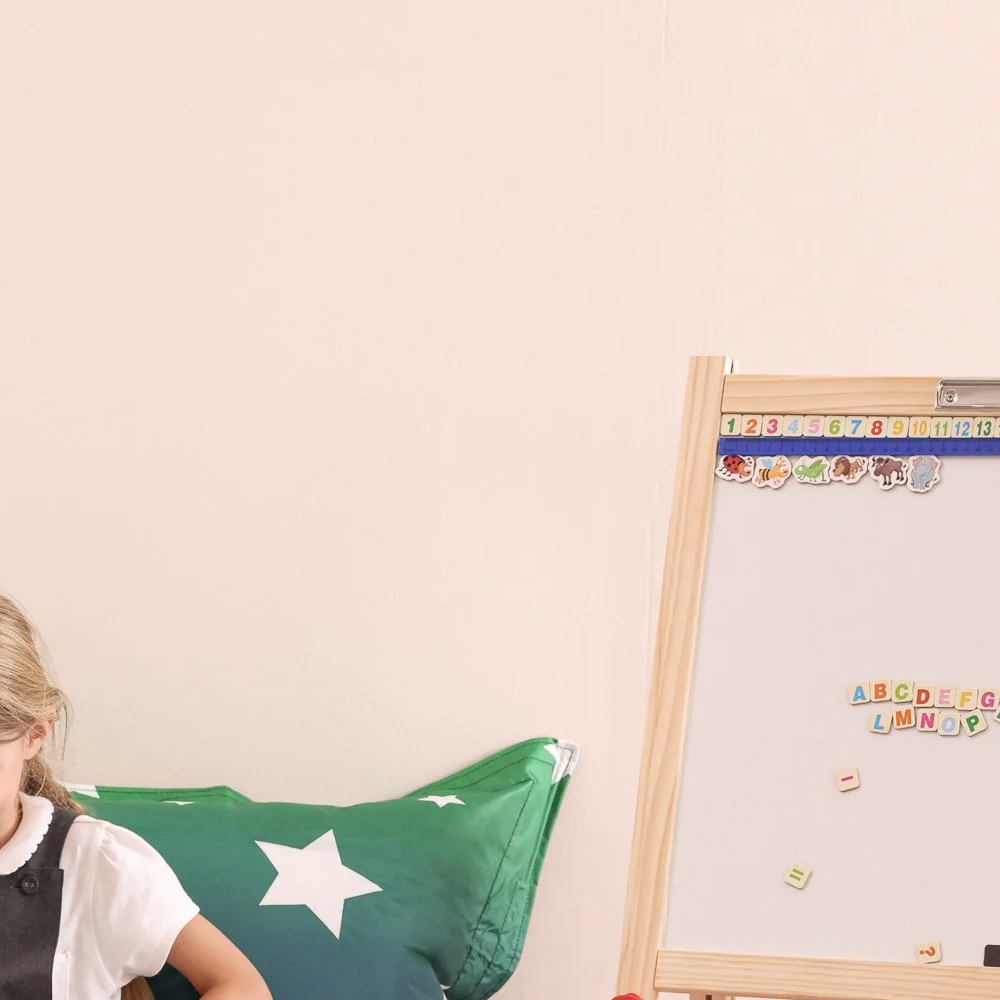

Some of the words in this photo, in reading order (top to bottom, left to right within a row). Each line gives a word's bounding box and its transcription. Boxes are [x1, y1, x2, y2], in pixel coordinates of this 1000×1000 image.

[727, 418, 736, 433] 1
[745, 419, 757, 434] 2
[766, 418, 778, 434] 3
[786, 418, 799, 434] 4
[808, 418, 820, 433] 5
[828, 419, 841, 435] 6
[850, 420, 862, 435] 7
[870, 420, 883, 435] 8
[892, 420, 904, 436] 9
[913, 421, 927, 436] 10
[934, 421, 948, 436] 11
[955, 421, 970, 436] 12
[977, 421, 992, 436] 13
